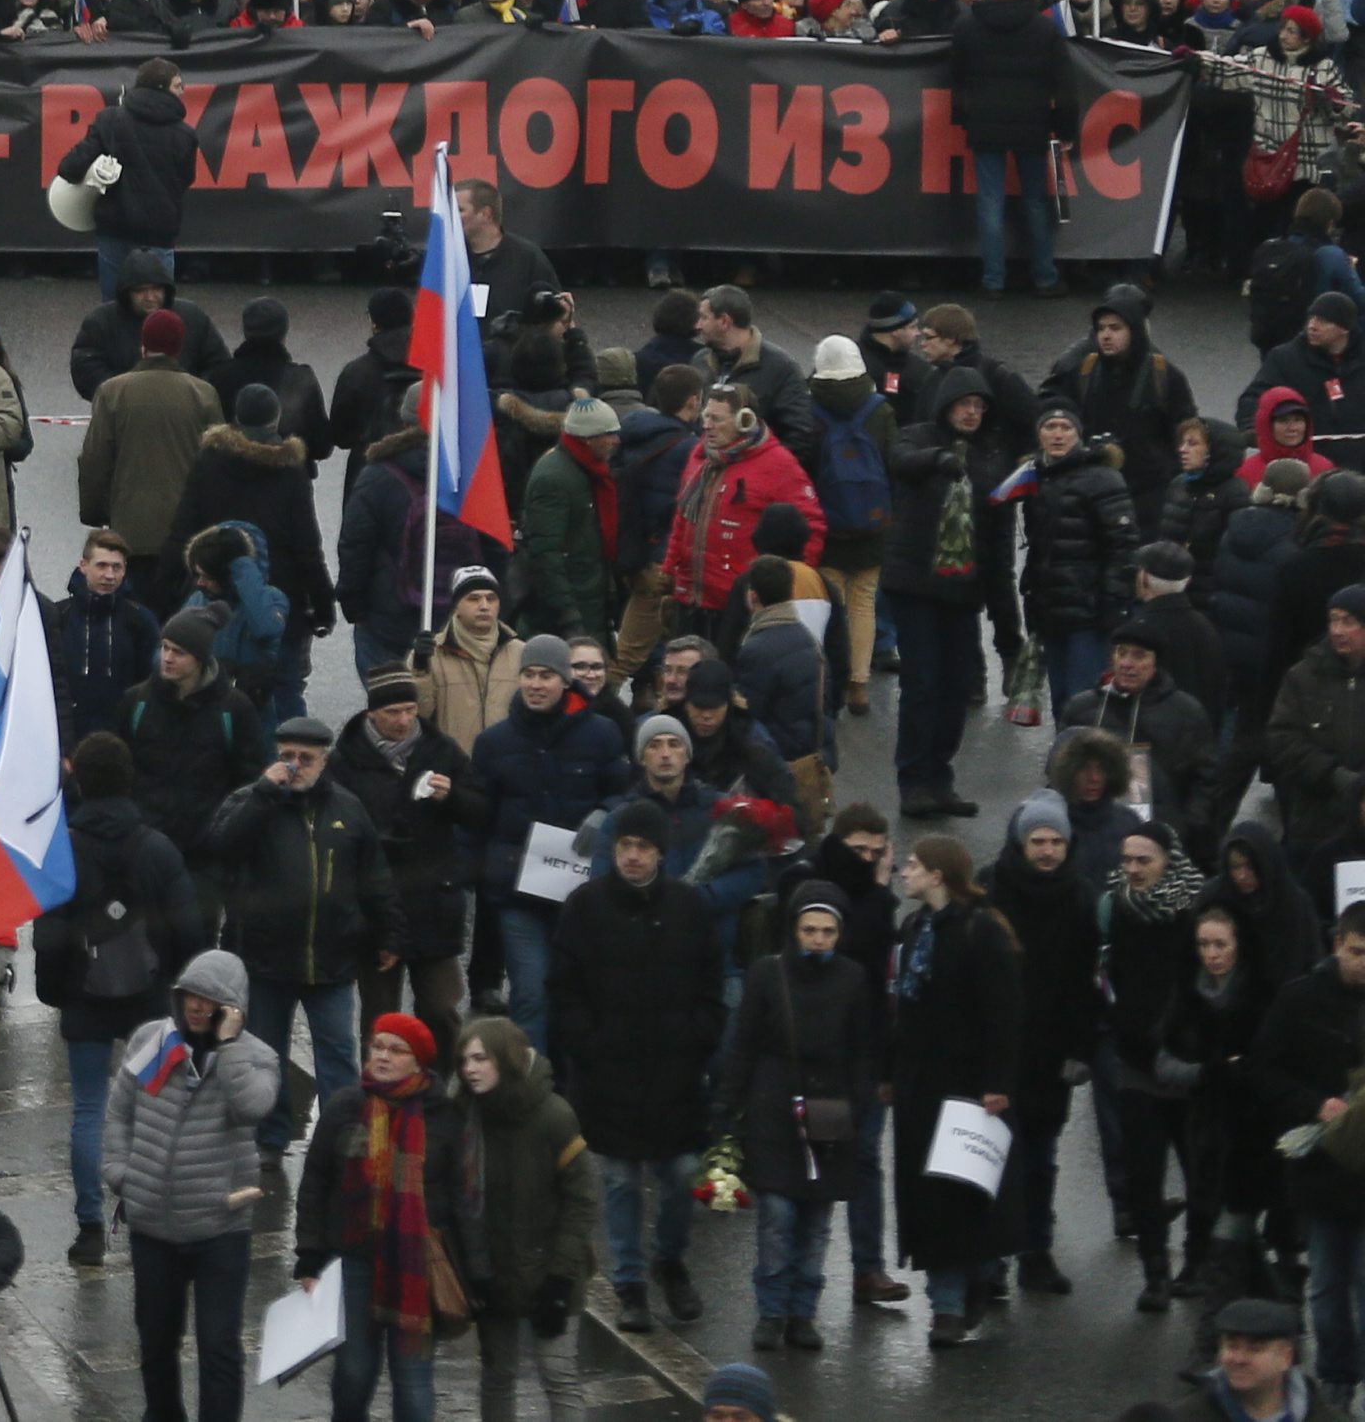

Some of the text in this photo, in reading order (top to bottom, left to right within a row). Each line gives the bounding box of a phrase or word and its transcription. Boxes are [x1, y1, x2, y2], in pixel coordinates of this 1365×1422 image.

[747, 83, 891, 195] ИЗ
[921, 88, 1143, 200] НС
[543, 856, 569, 870] НЕТ
